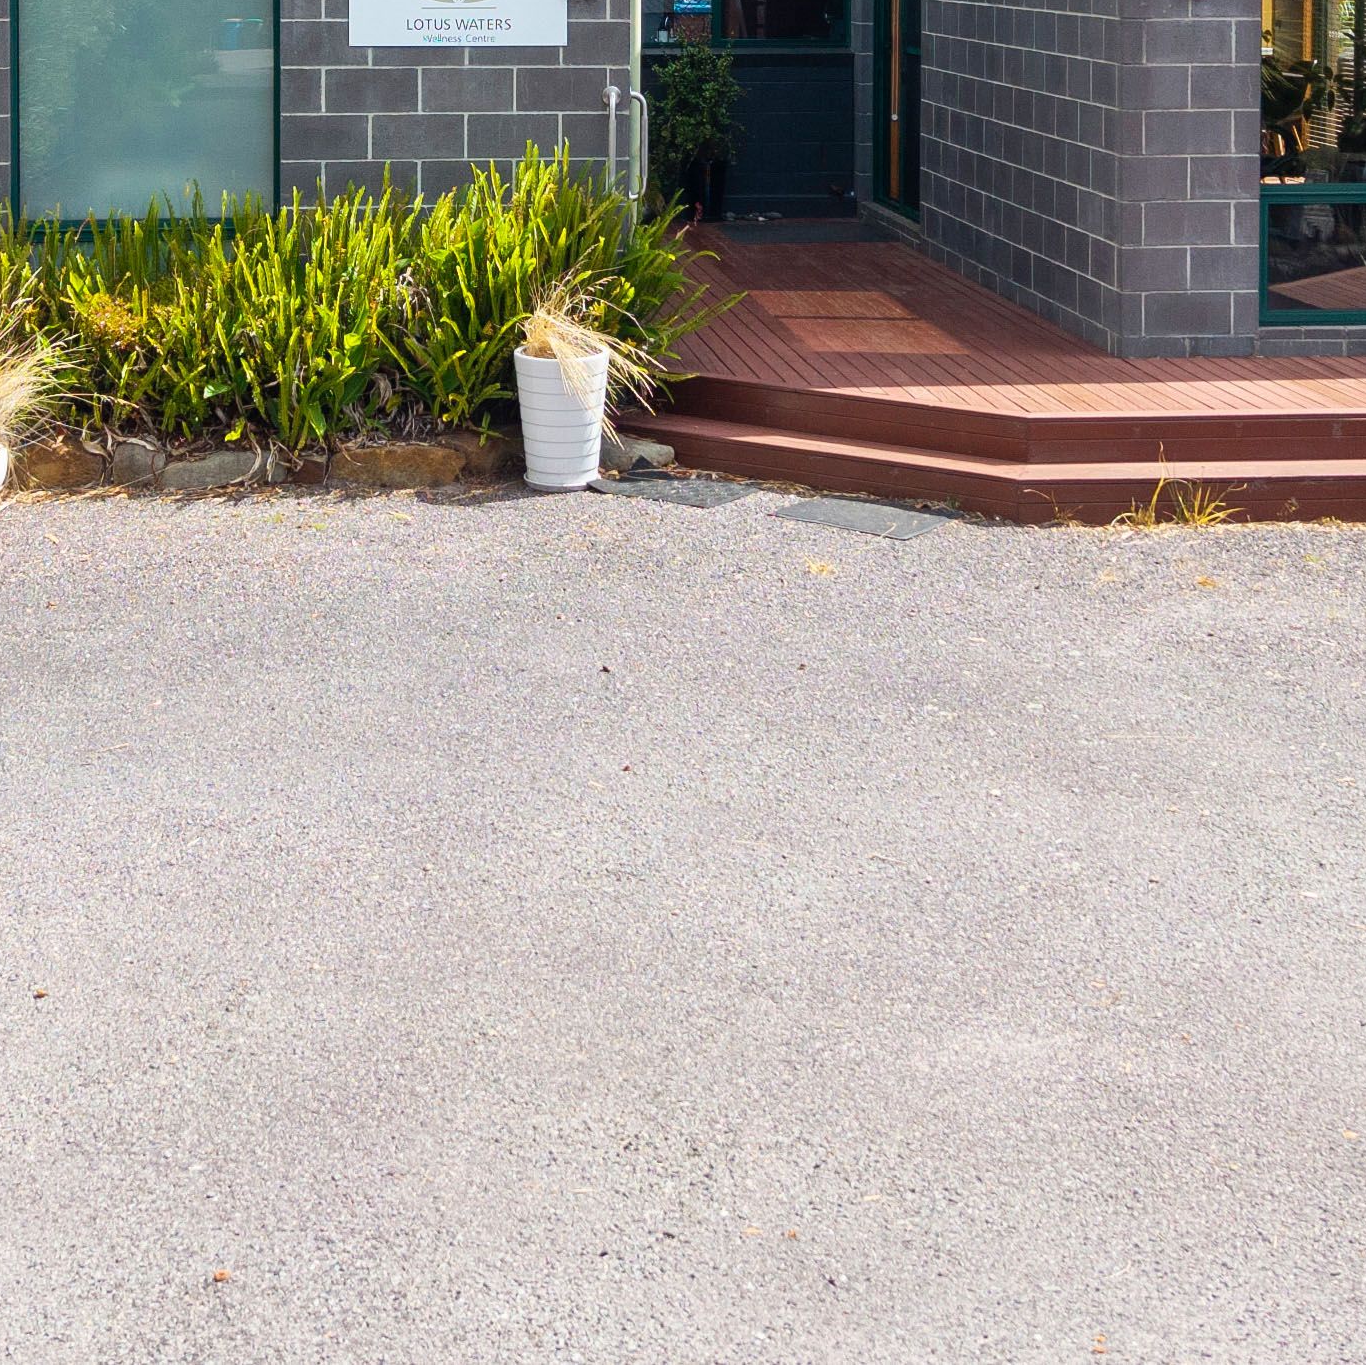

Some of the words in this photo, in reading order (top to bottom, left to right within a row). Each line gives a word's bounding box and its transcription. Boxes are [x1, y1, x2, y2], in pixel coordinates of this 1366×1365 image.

[406, 18, 451, 31] LOTUS
[455, 18, 512, 31] WATERS
[423, 34, 462, 43] Wellness
[465, 34, 496, 43] Centre
